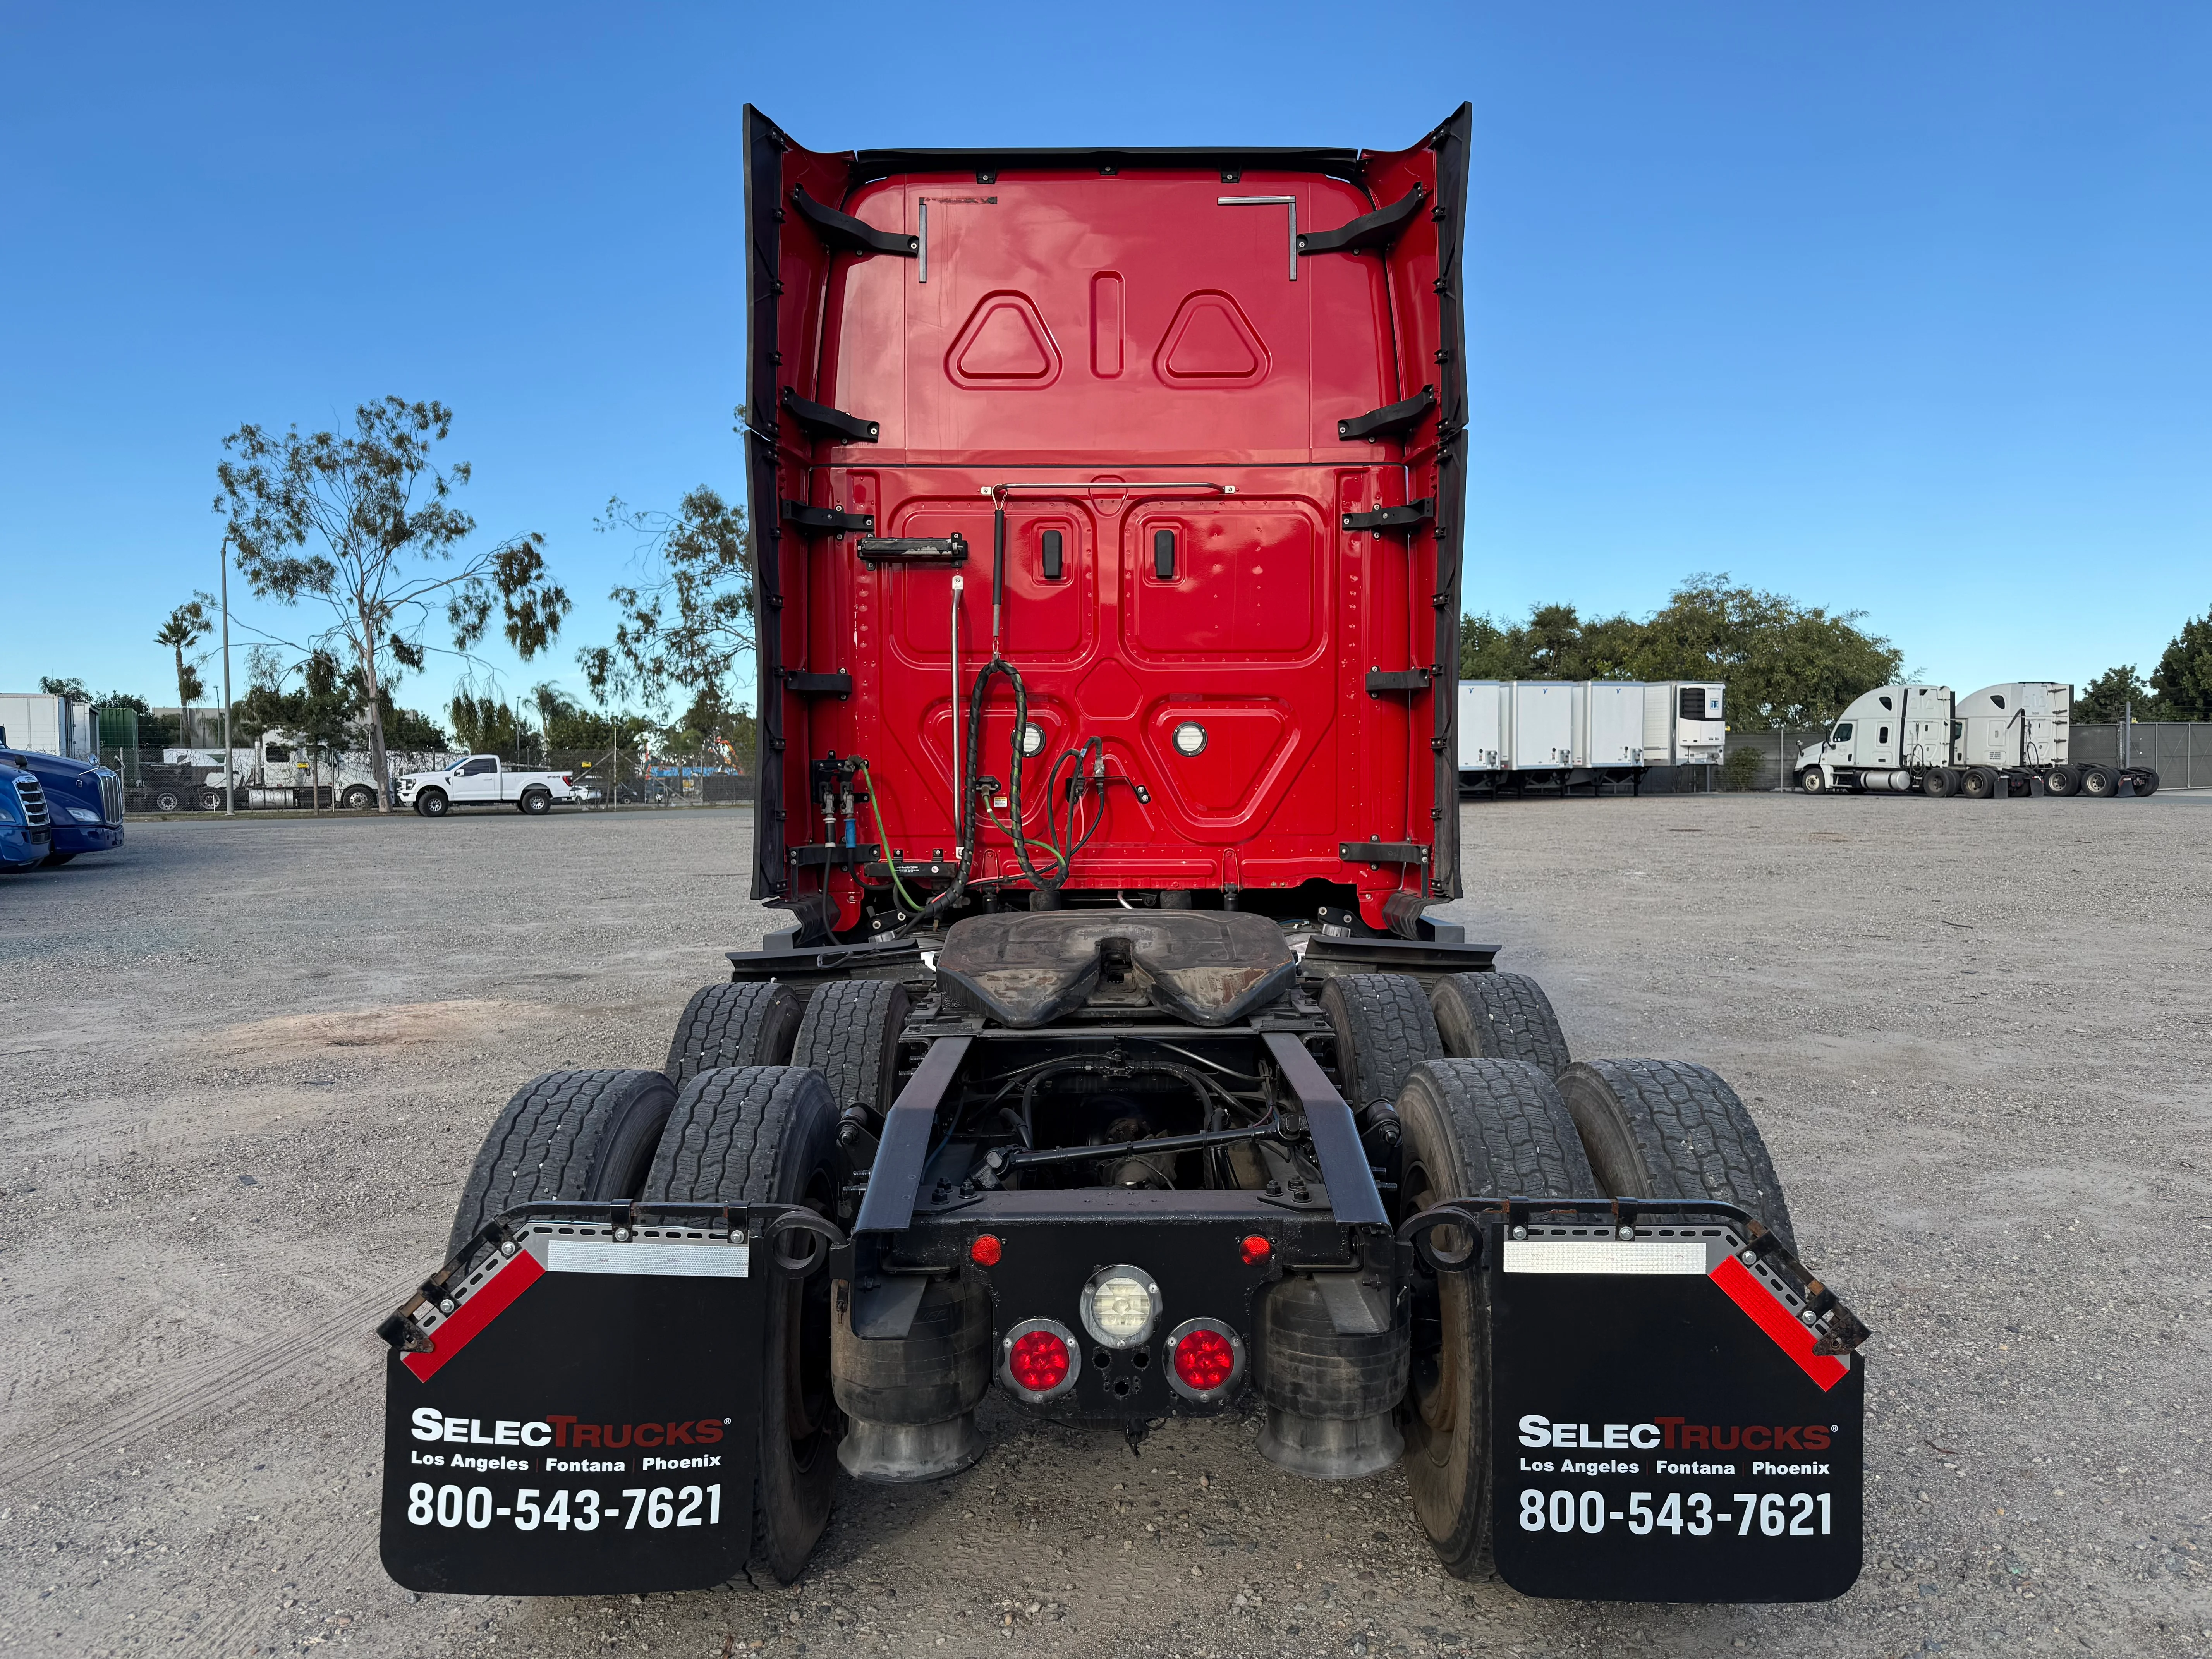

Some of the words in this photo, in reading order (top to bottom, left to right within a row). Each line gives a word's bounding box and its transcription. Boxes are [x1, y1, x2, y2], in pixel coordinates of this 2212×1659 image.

[412, 1451, 445, 1466] Los
[450, 1453, 529, 1472] Angeles
[546, 1458, 625, 1472] Fontana
[642, 1454, 721, 1471] Phoenix
[1520, 1458, 1554, 1472] Los
[1560, 1459, 1639, 1476] Angeles
[1657, 1460, 1735, 1475] Fontana
[1752, 1461, 1830, 1475] Phoenix
[408, 1482, 721, 1531] 800-543-7621
[1520, 1489, 1831, 1536] 800-543-7621
